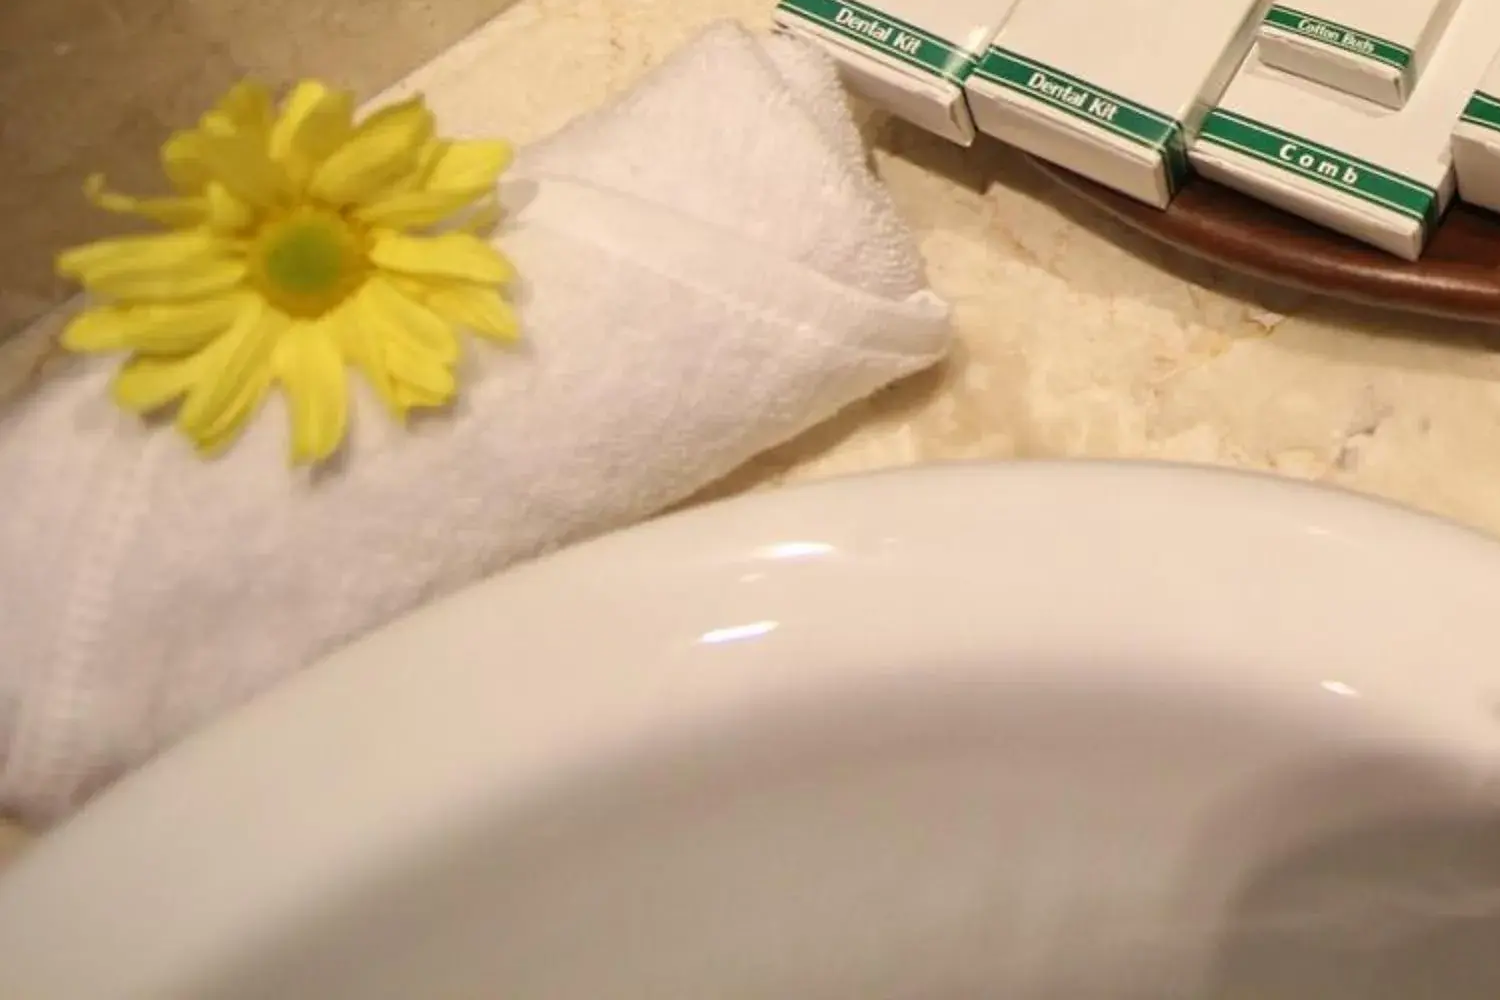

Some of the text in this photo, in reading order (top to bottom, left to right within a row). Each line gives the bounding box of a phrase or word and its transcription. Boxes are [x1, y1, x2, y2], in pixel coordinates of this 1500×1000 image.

[835, 7, 922, 55] Dental Kit
[1297, 18, 1340, 42] Cotton
[1027, 71, 1118, 121] Dental Kit
[1279, 143, 1359, 184] Comb
